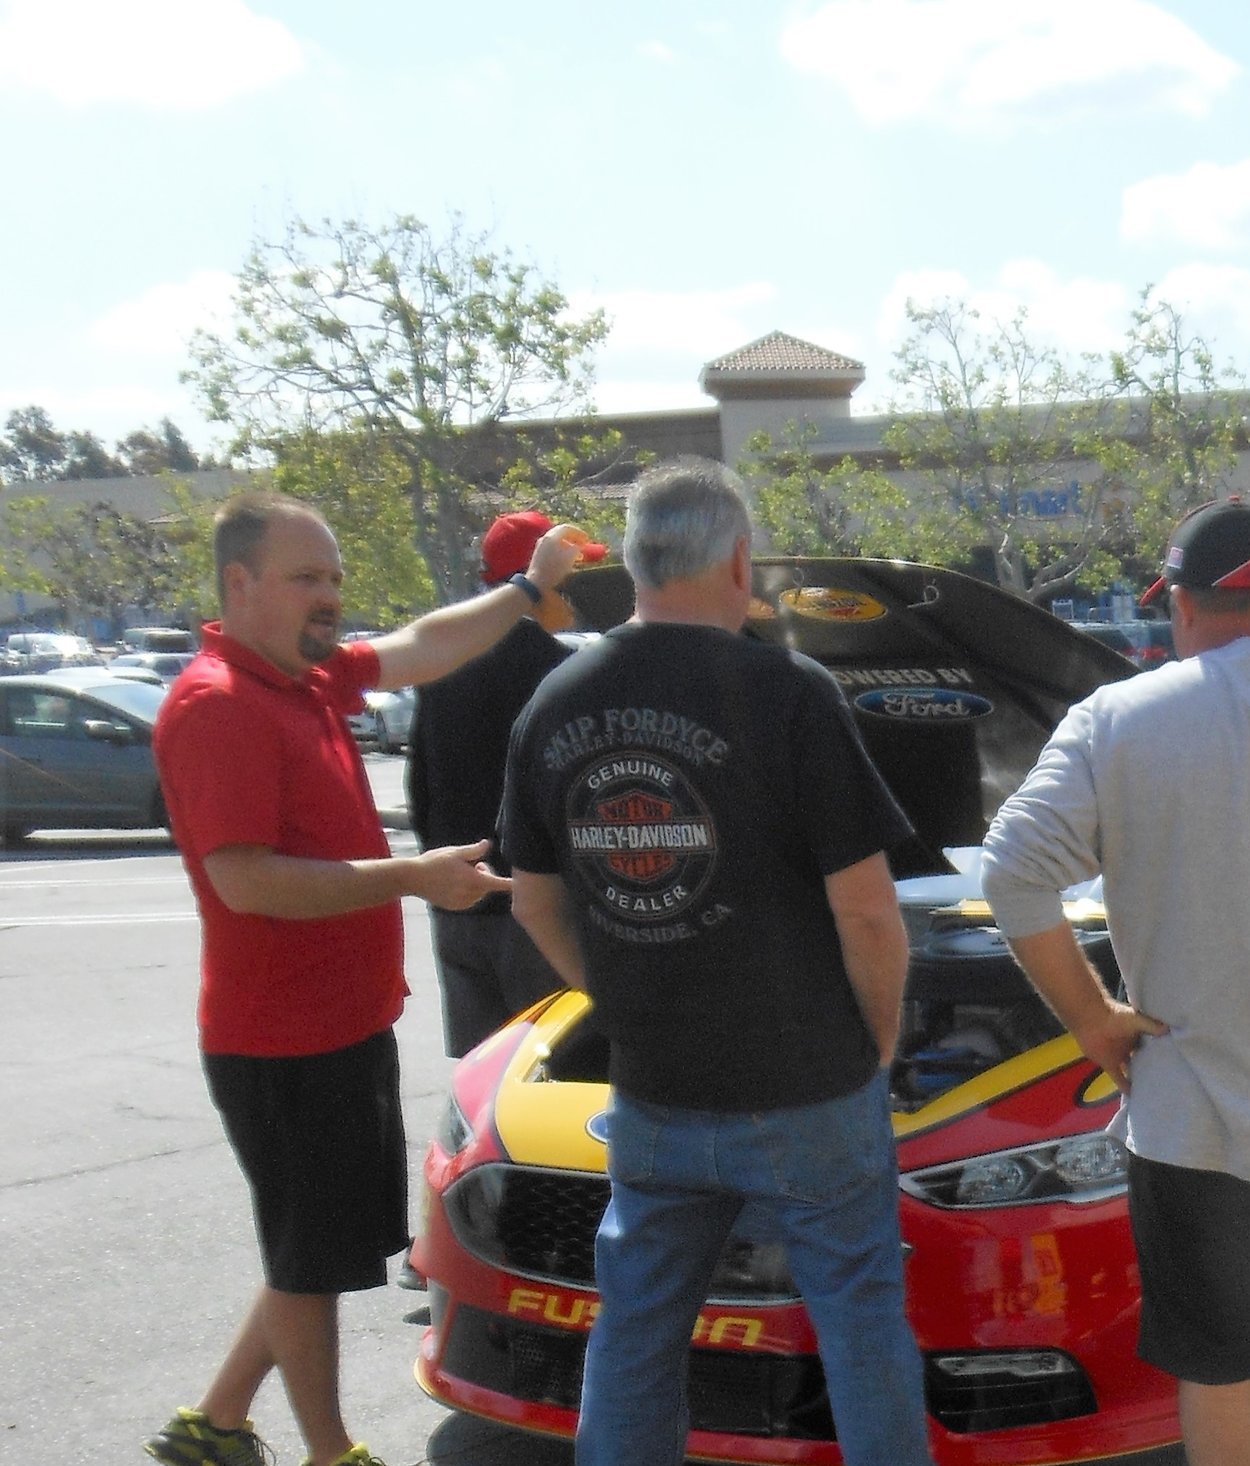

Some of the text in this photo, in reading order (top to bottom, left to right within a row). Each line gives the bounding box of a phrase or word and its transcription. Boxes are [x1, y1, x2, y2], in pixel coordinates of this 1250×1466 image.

[832, 668, 974, 685] OWERED BY
[881, 692, 971, 716] Ford
[604, 707, 728, 764] FORDYCE
[588, 760, 674, 789] GENUINE
[570, 824, 708, 849] HARLEY-DAVIDSON
[605, 885, 688, 911] DEALER
